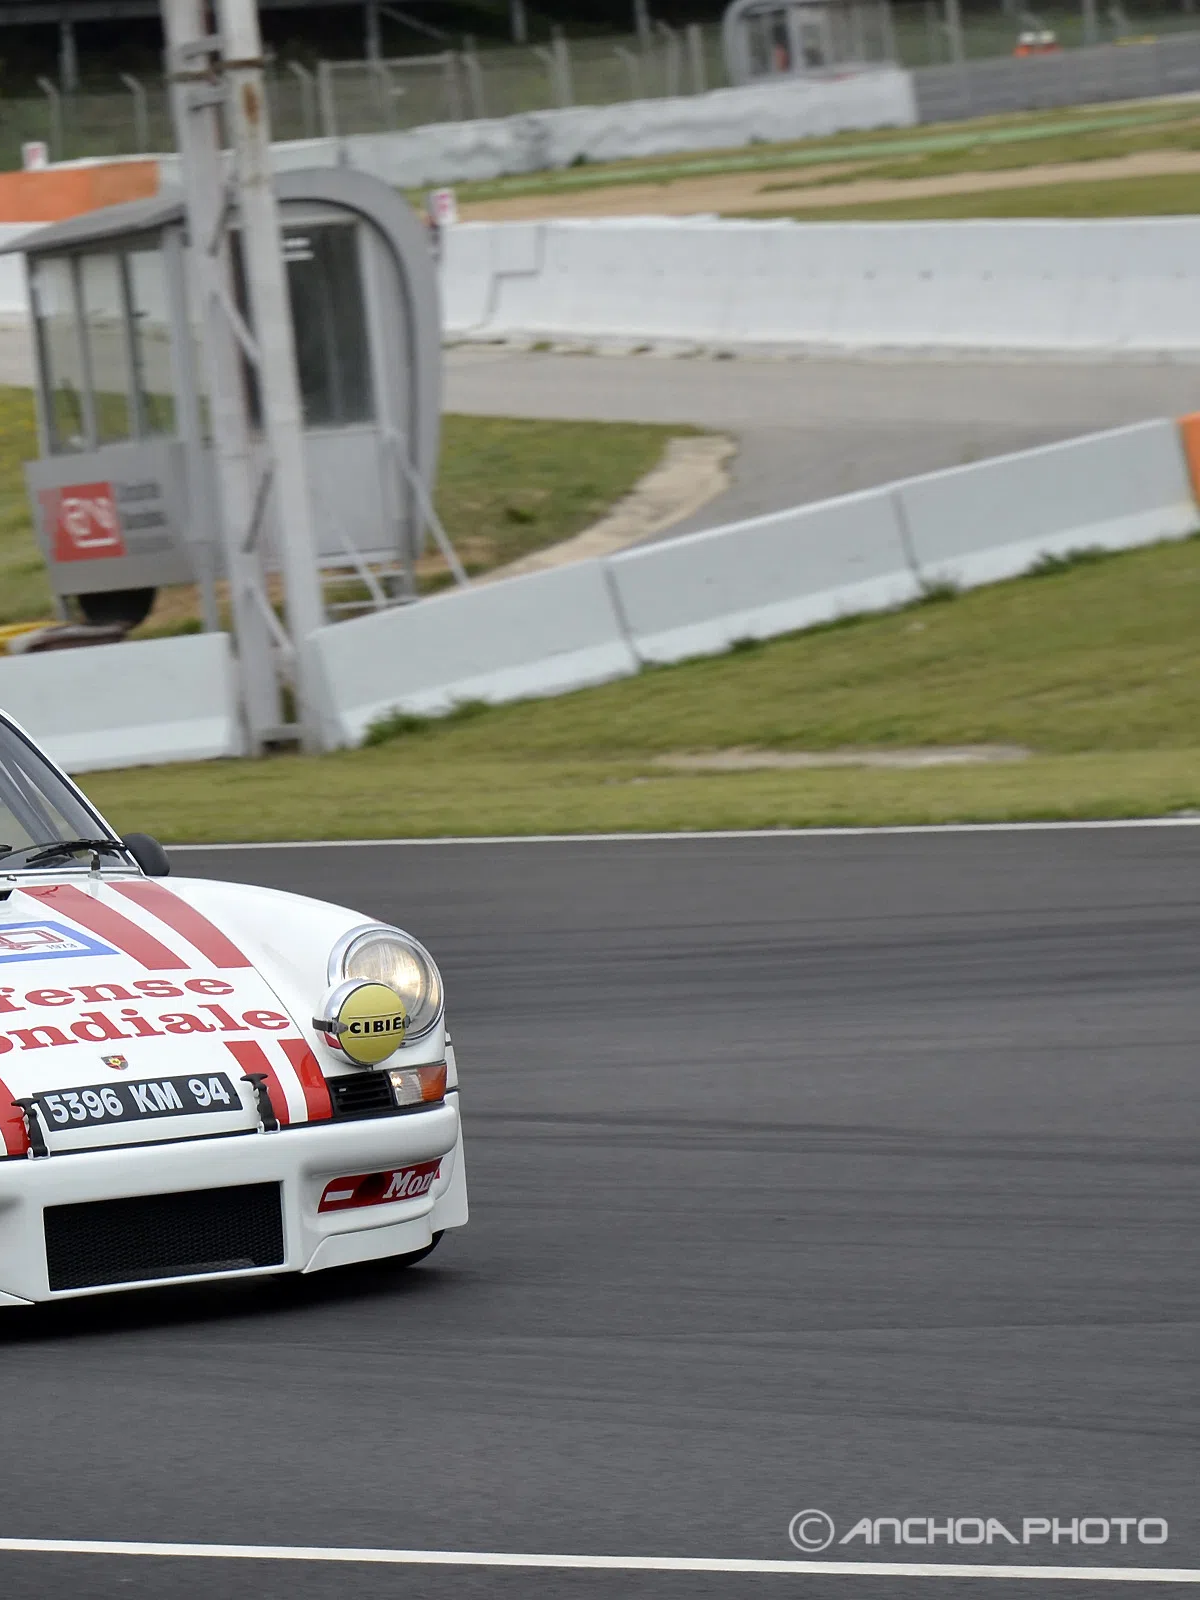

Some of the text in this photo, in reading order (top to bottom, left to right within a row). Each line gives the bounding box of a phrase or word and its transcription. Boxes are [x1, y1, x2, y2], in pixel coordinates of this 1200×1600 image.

[43, 1076, 231, 1124] 5396 KM 94
